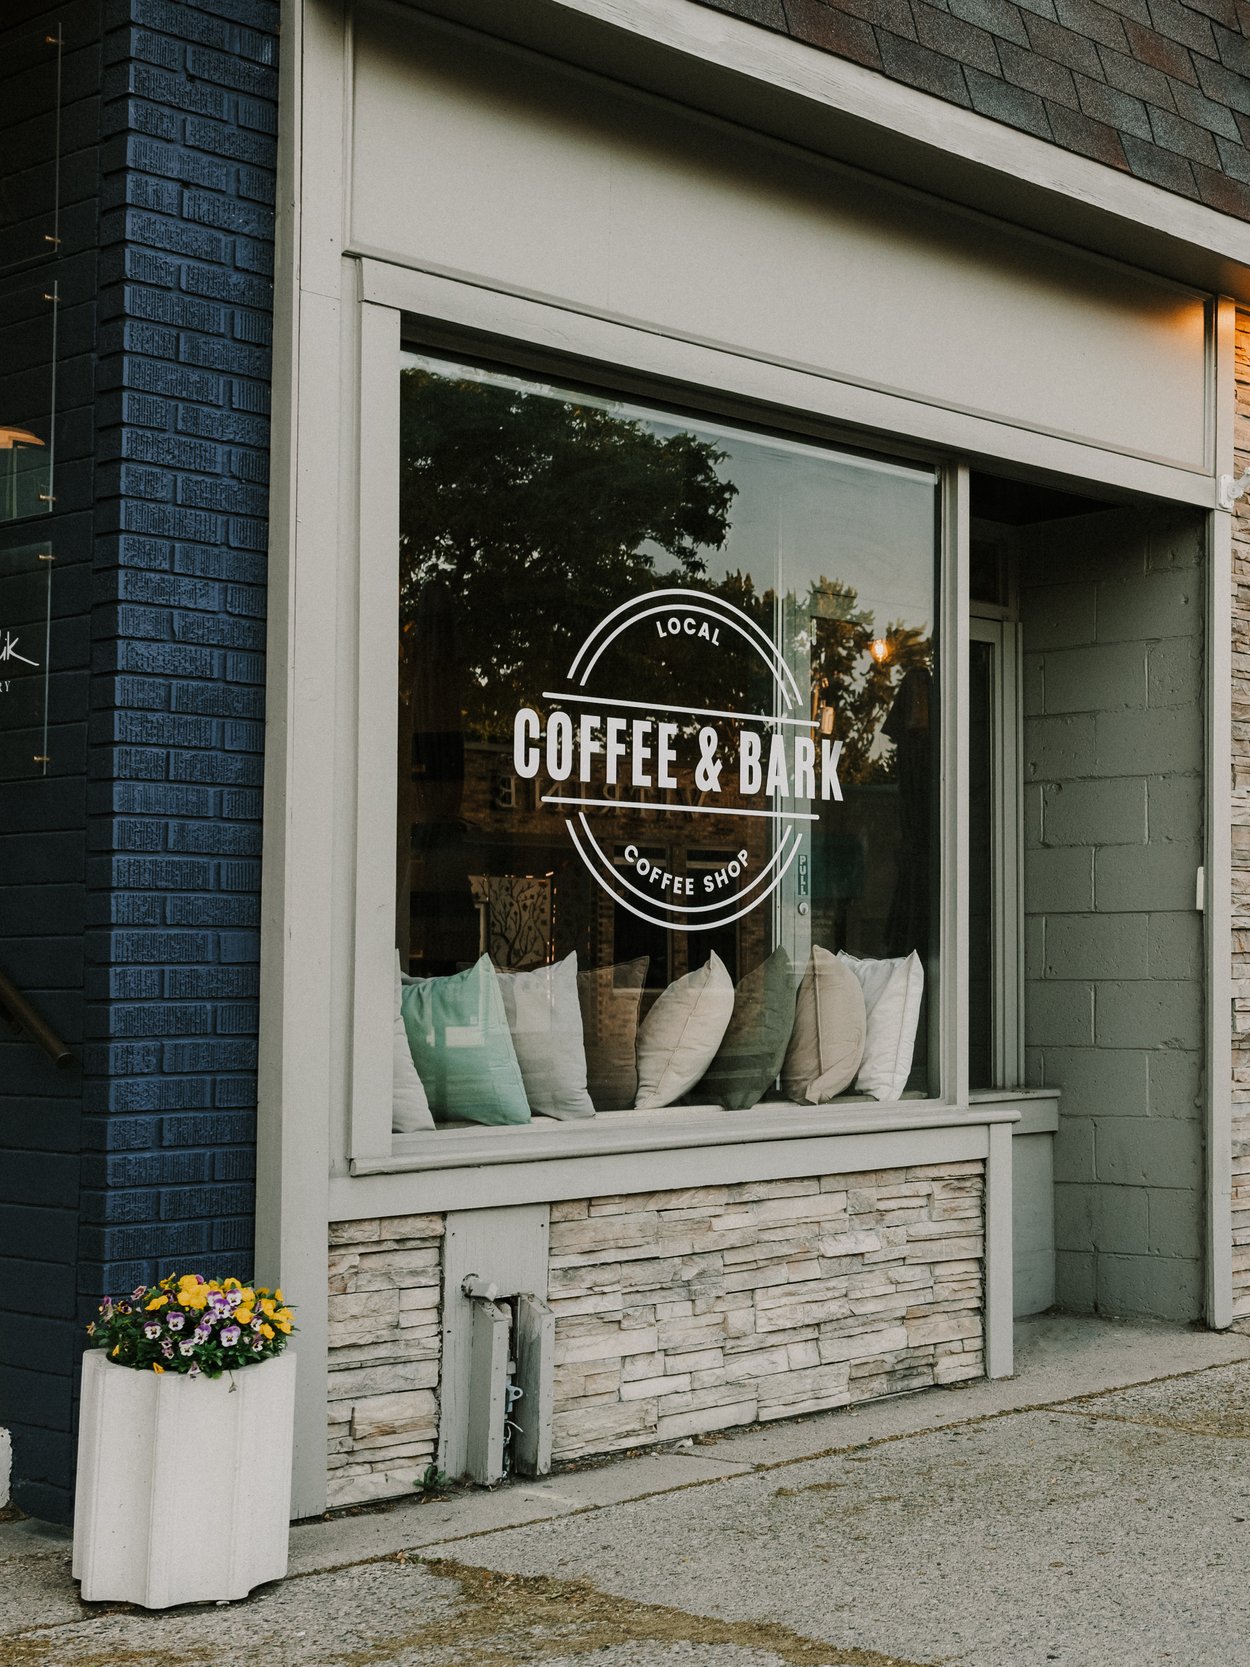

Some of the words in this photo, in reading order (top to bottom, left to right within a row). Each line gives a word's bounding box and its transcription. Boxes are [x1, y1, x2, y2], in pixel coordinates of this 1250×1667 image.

[655, 616, 721, 646] LOCAL
[513, 707, 679, 789] COFFEE
[694, 726, 724, 793] &
[739, 730, 844, 801] BARK
[624, 844, 695, 895] COFFEE
[703, 849, 749, 893] SHOP
[799, 855, 807, 895] PULL
